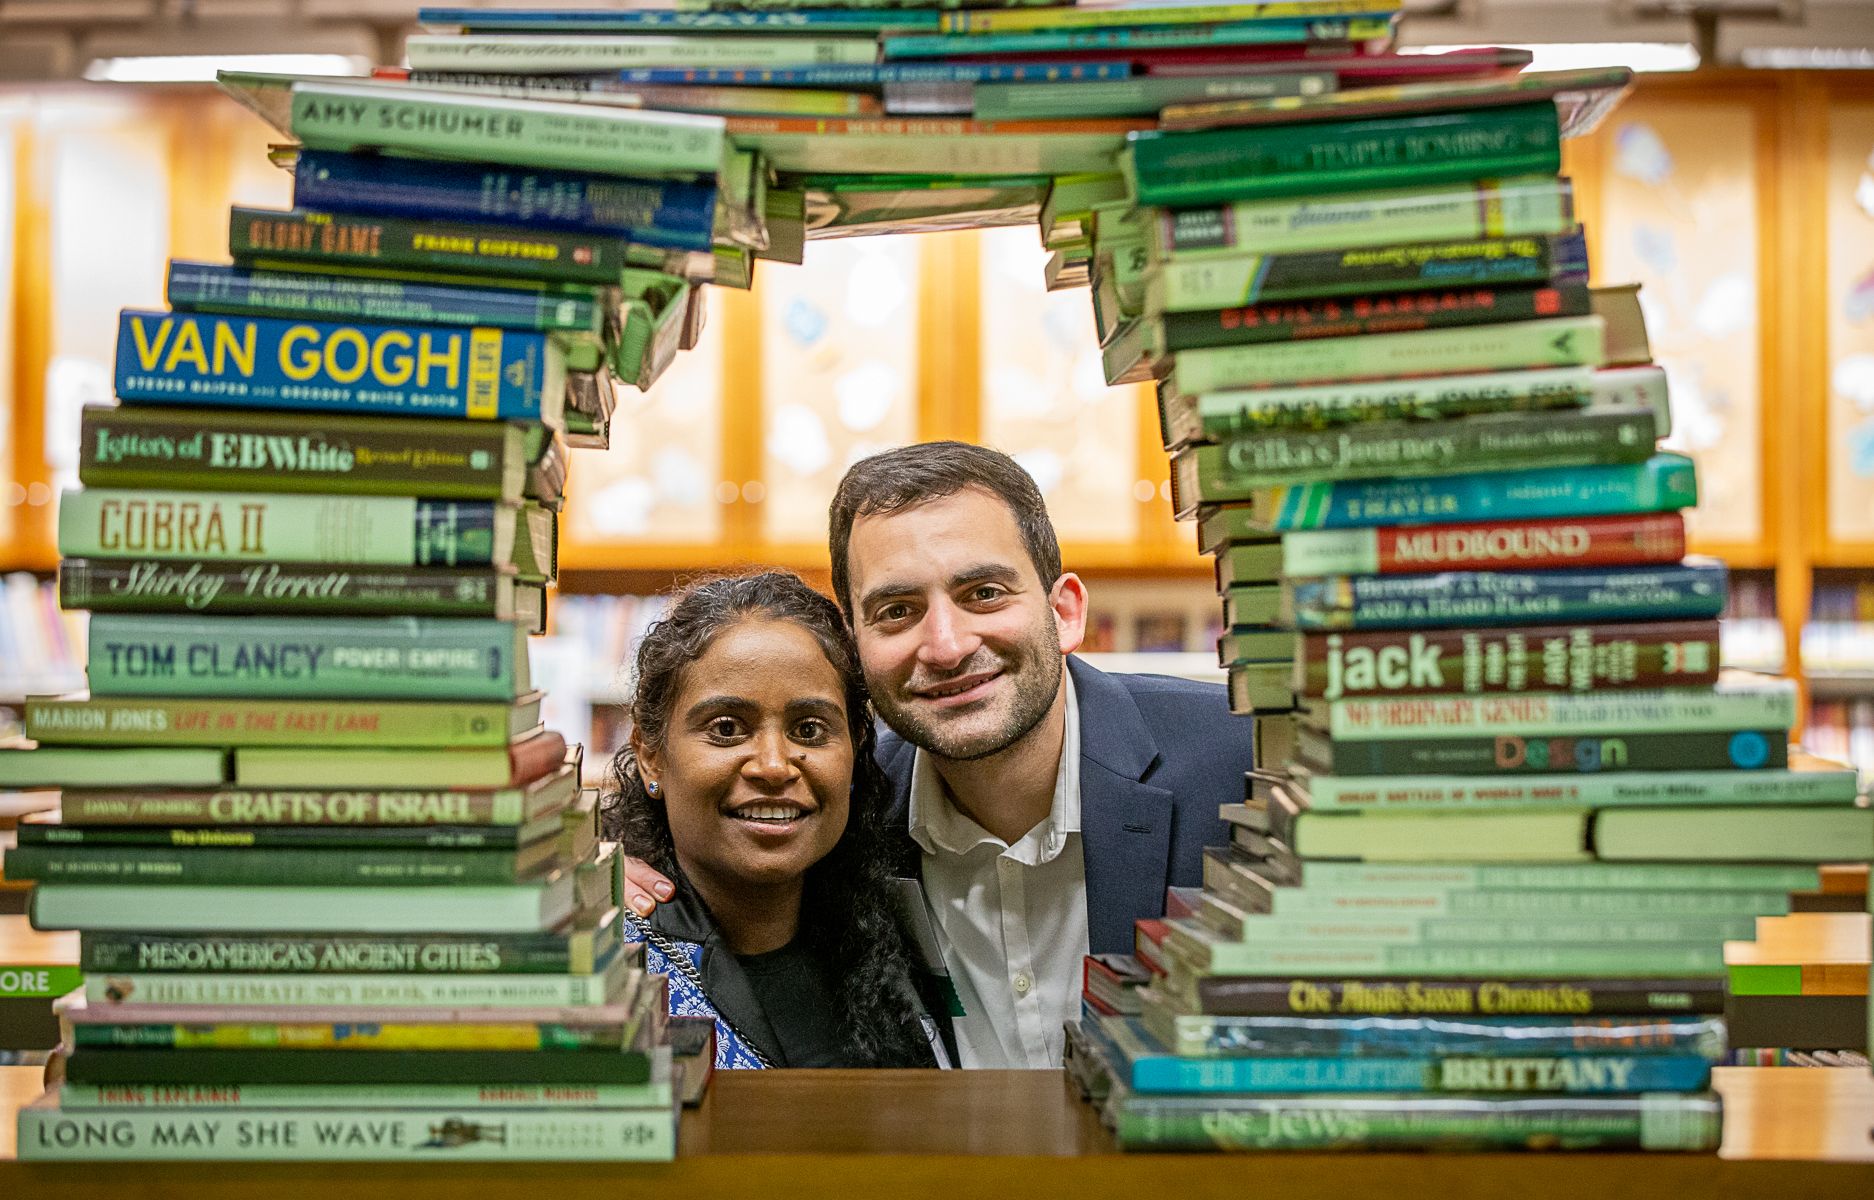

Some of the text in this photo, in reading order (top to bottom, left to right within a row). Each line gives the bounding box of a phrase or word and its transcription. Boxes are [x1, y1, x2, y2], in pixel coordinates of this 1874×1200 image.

[303, 100, 524, 139] AMY SCHUMER
[130, 316, 462, 389] VAN GOGH
[178, 431, 203, 459] of
[1330, 433, 1455, 470] Journey
[100, 500, 268, 554] COBRA II
[1395, 526, 1590, 563] MUDBOUND
[110, 561, 226, 608] Shirley
[106, 642, 325, 680] TOM CLANCY
[1323, 634, 1444, 700] jack
[33, 707, 106, 730] MARION
[111, 708, 168, 732] JONES
[175, 711, 209, 731] LIFE
[284, 713, 328, 731] FAST
[335, 713, 379, 732] LANE
[1494, 735, 1629, 772] Design
[208, 792, 323, 823] CRAFTS
[327, 792, 373, 823] OF
[377, 792, 470, 823] ISRAEL
[320, 943, 419, 971] ANCIENT
[421, 943, 502, 971] CITIES
[1441, 1057, 1634, 1091] BRITTANY
[38, 1119, 406, 1148] LONG MAY SHE WAVE
